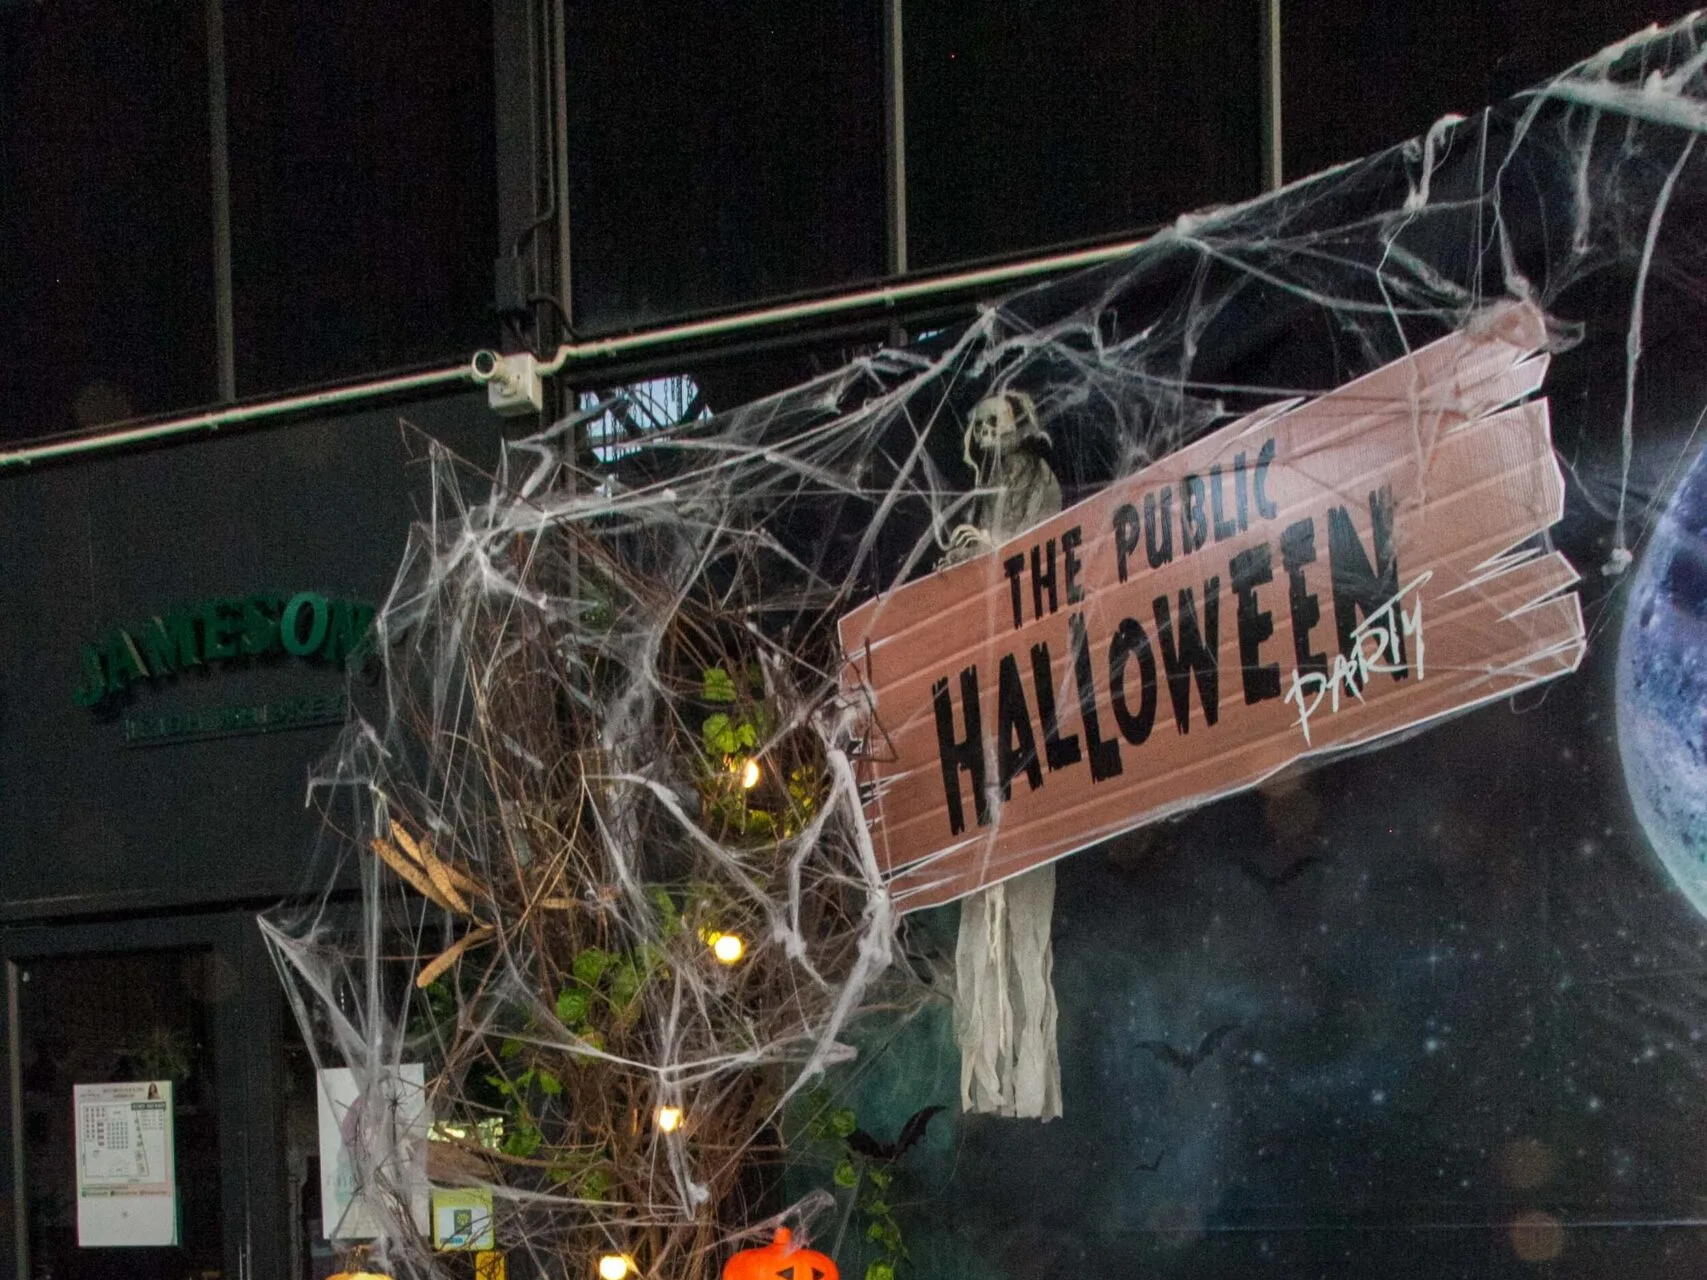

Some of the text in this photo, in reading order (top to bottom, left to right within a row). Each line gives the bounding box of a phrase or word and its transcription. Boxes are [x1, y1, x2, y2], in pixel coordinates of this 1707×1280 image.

[1004, 437, 1278, 629] THE PUBLIC
[70, 590, 377, 709] JAMESON
[932, 483, 1409, 836] HALLOWEEN
[1285, 570, 1433, 746] PARTY
